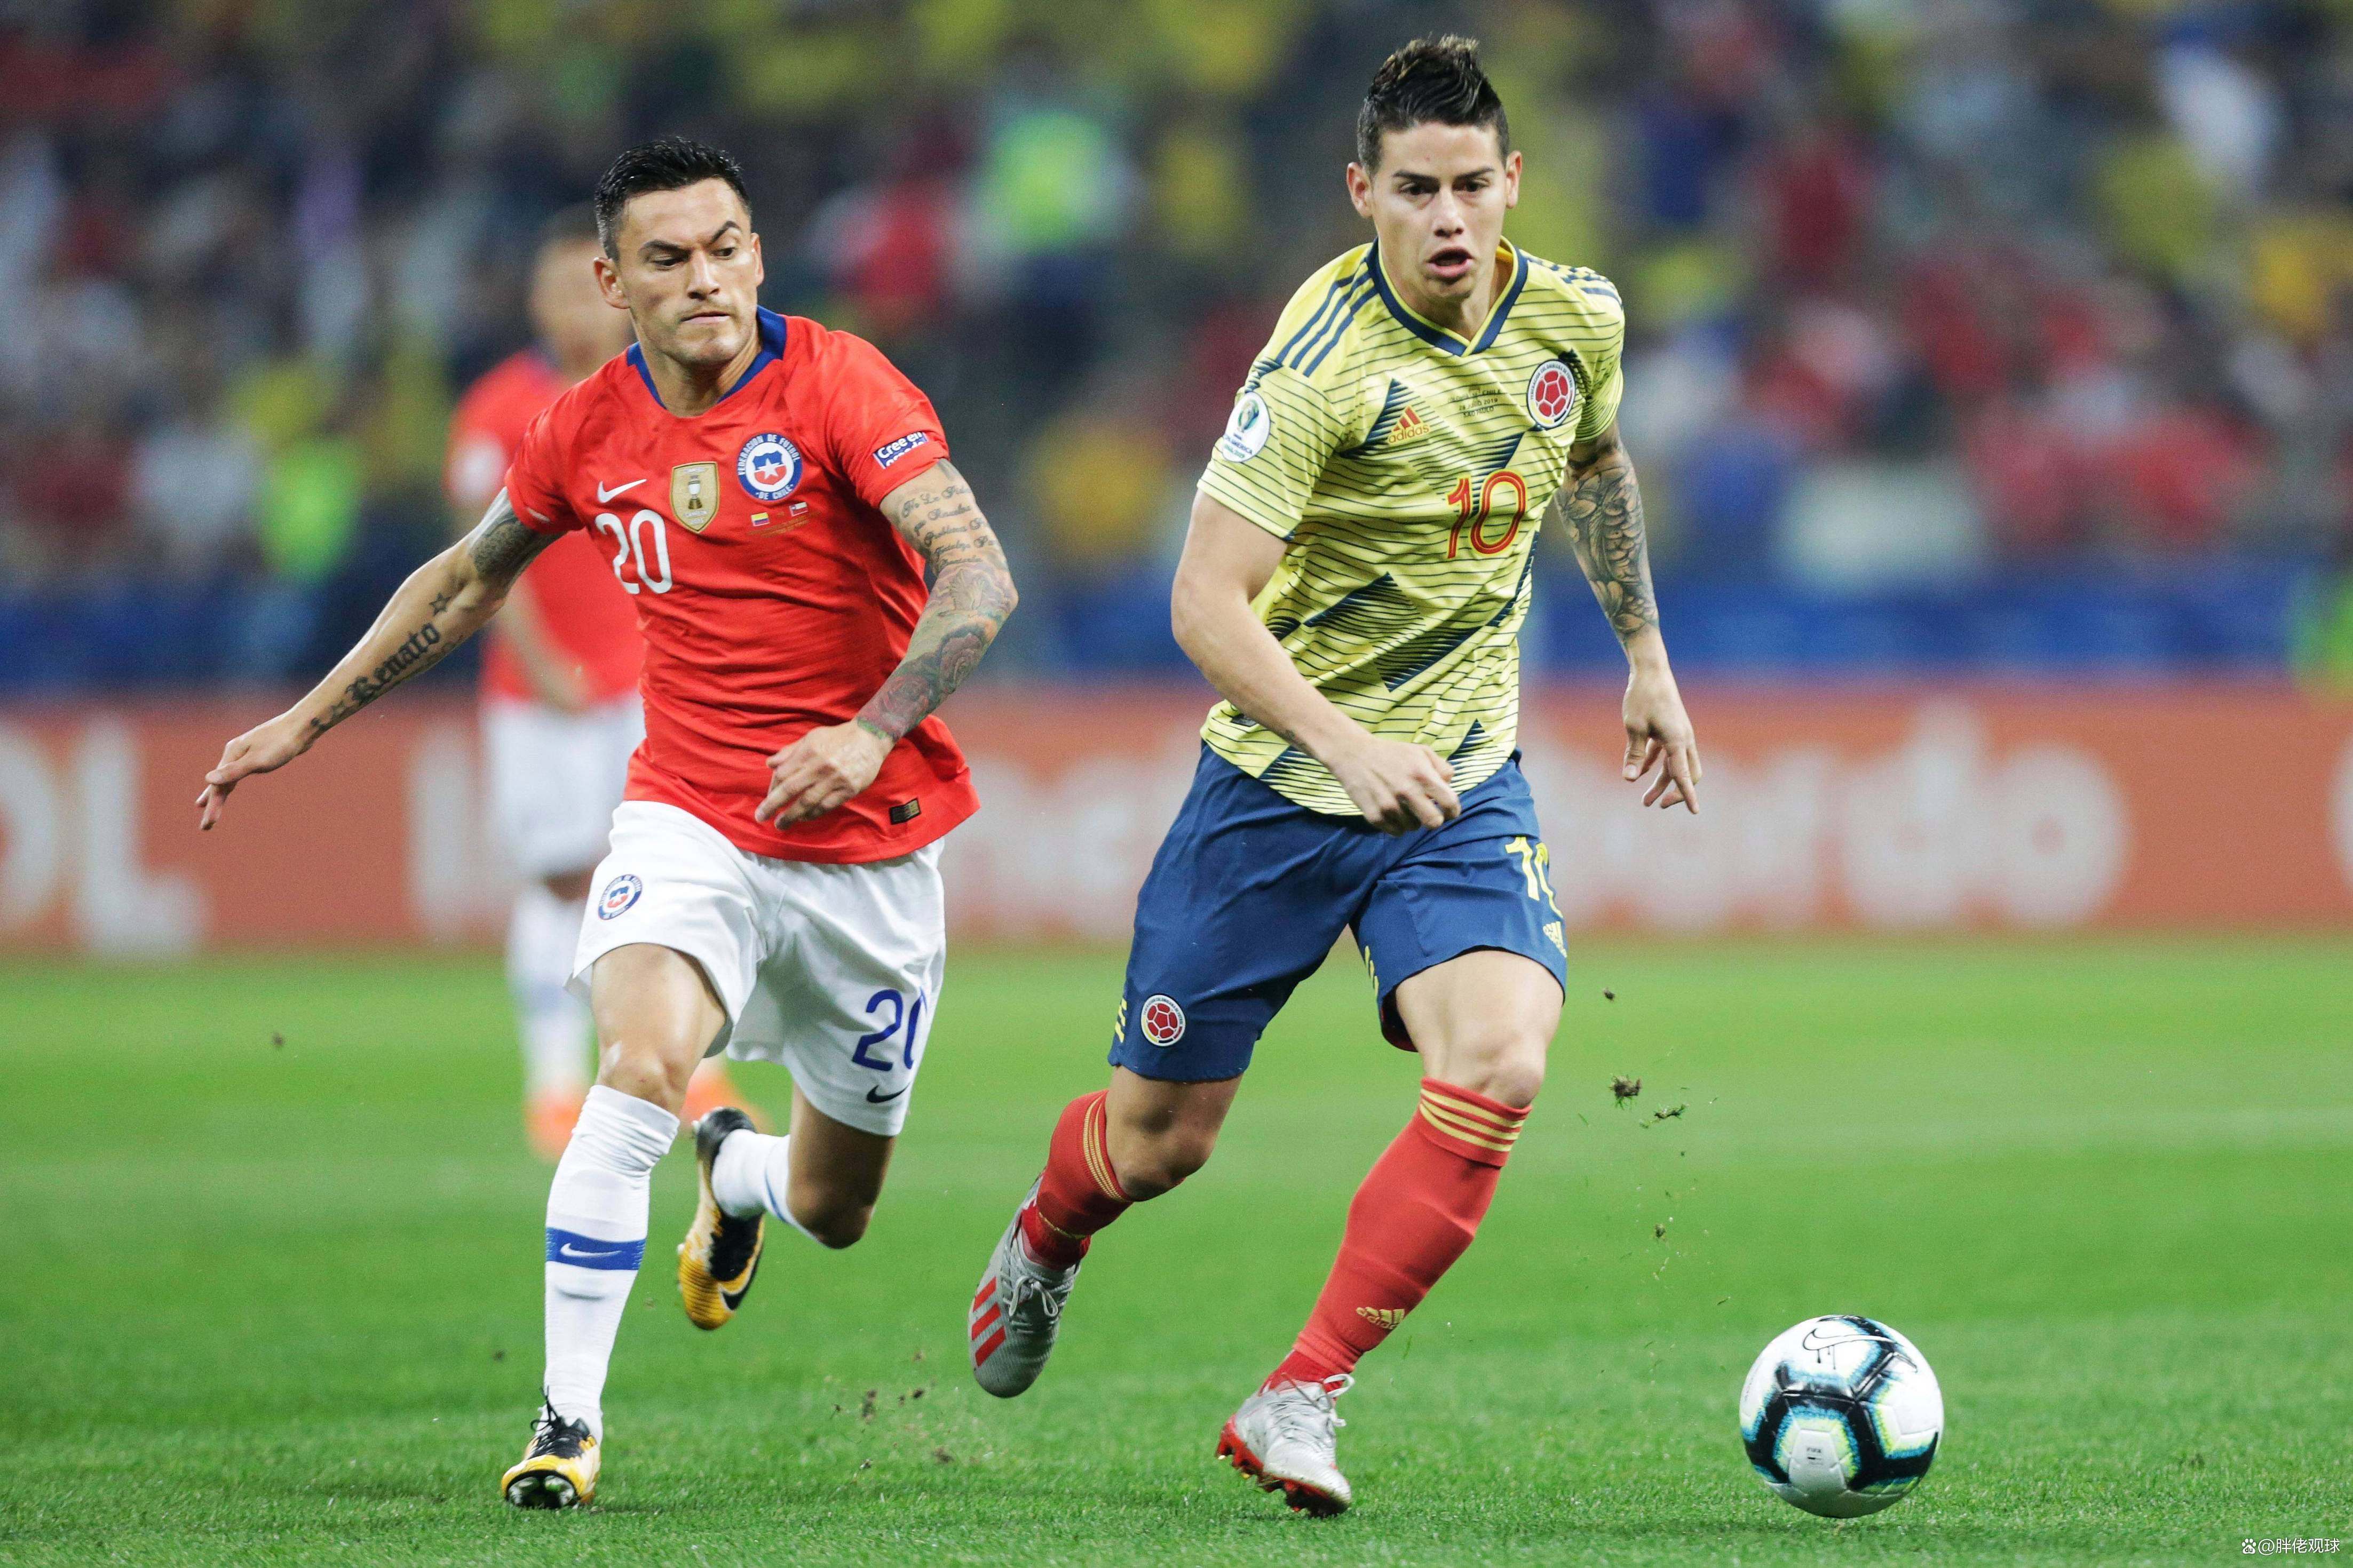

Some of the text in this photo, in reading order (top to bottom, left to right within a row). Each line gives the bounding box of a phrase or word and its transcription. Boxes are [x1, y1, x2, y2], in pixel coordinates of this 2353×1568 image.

[767, 434, 777, 442] DE
[779, 437, 801, 461] FUTBOL
[877, 437, 908, 459] Cree
[907, 432, 923, 442] en
[1389, 425, 1430, 443] adidas
[758, 491, 769, 500] DE
[1446, 469, 1526, 559] 10
[595, 508, 672, 594] 20
